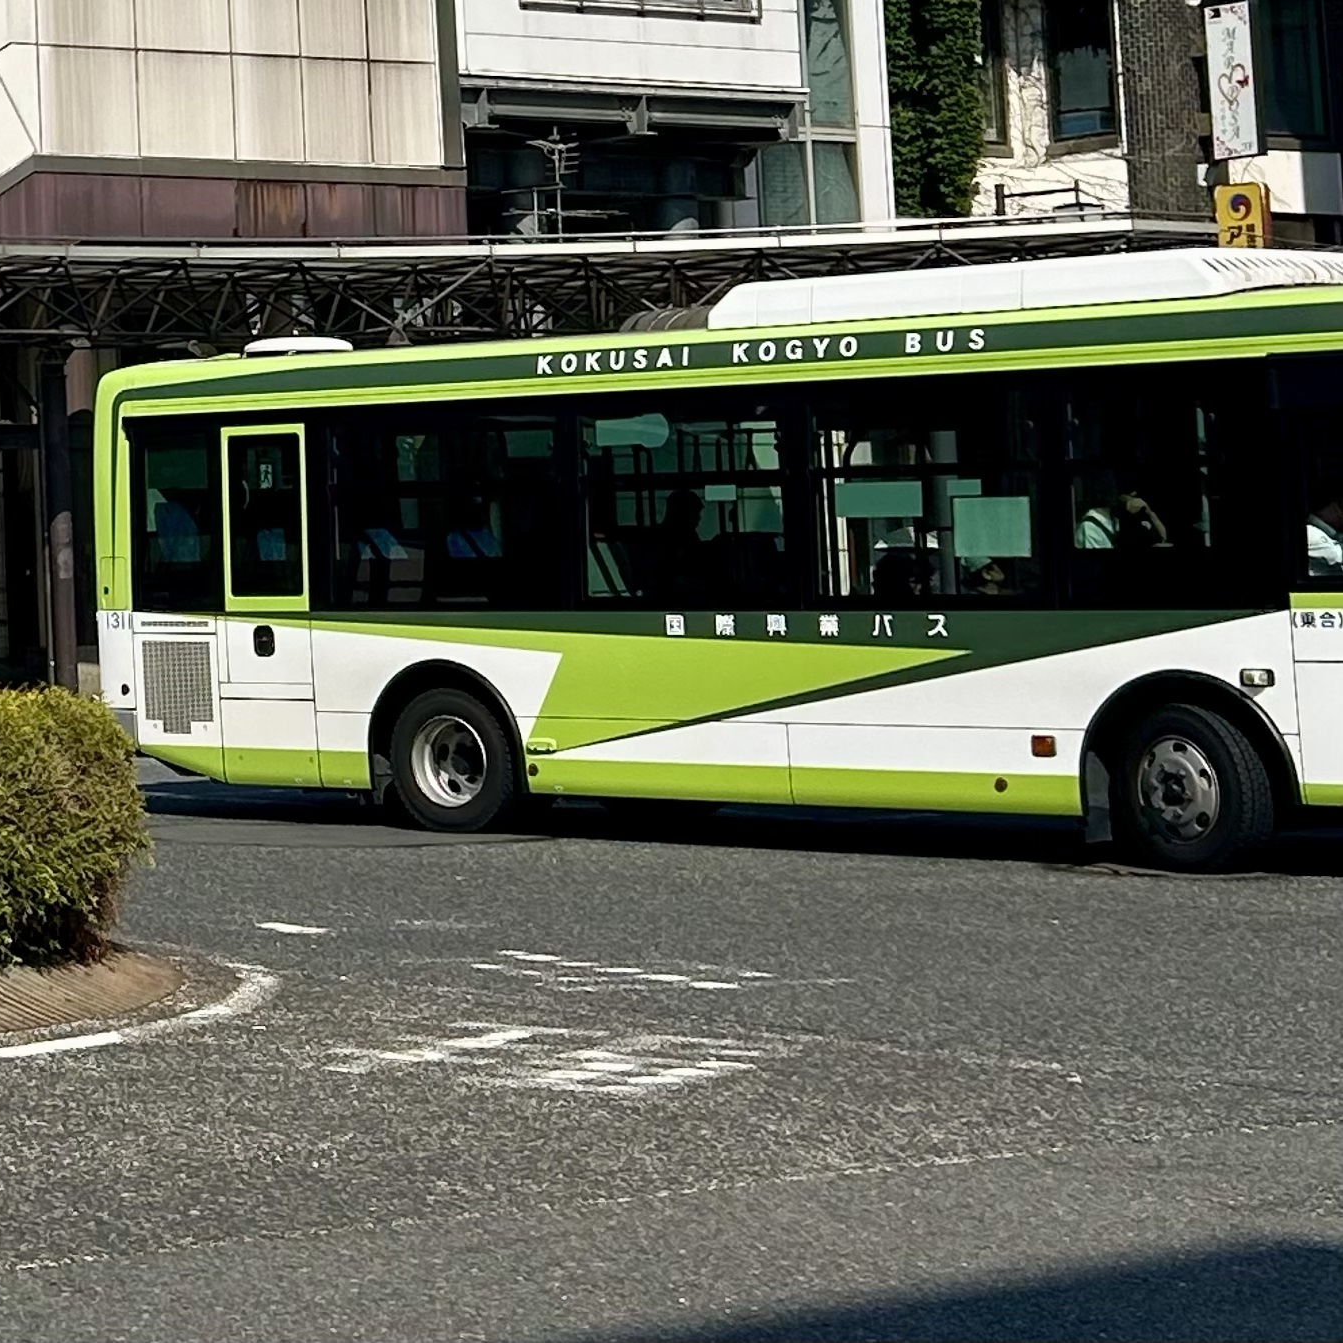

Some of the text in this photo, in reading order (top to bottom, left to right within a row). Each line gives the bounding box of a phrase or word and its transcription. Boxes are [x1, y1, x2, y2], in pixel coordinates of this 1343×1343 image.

[536, 328, 987, 375] KOKUSAI KOGYO BUS
[665, 613, 949, 637] 国際興業バス
